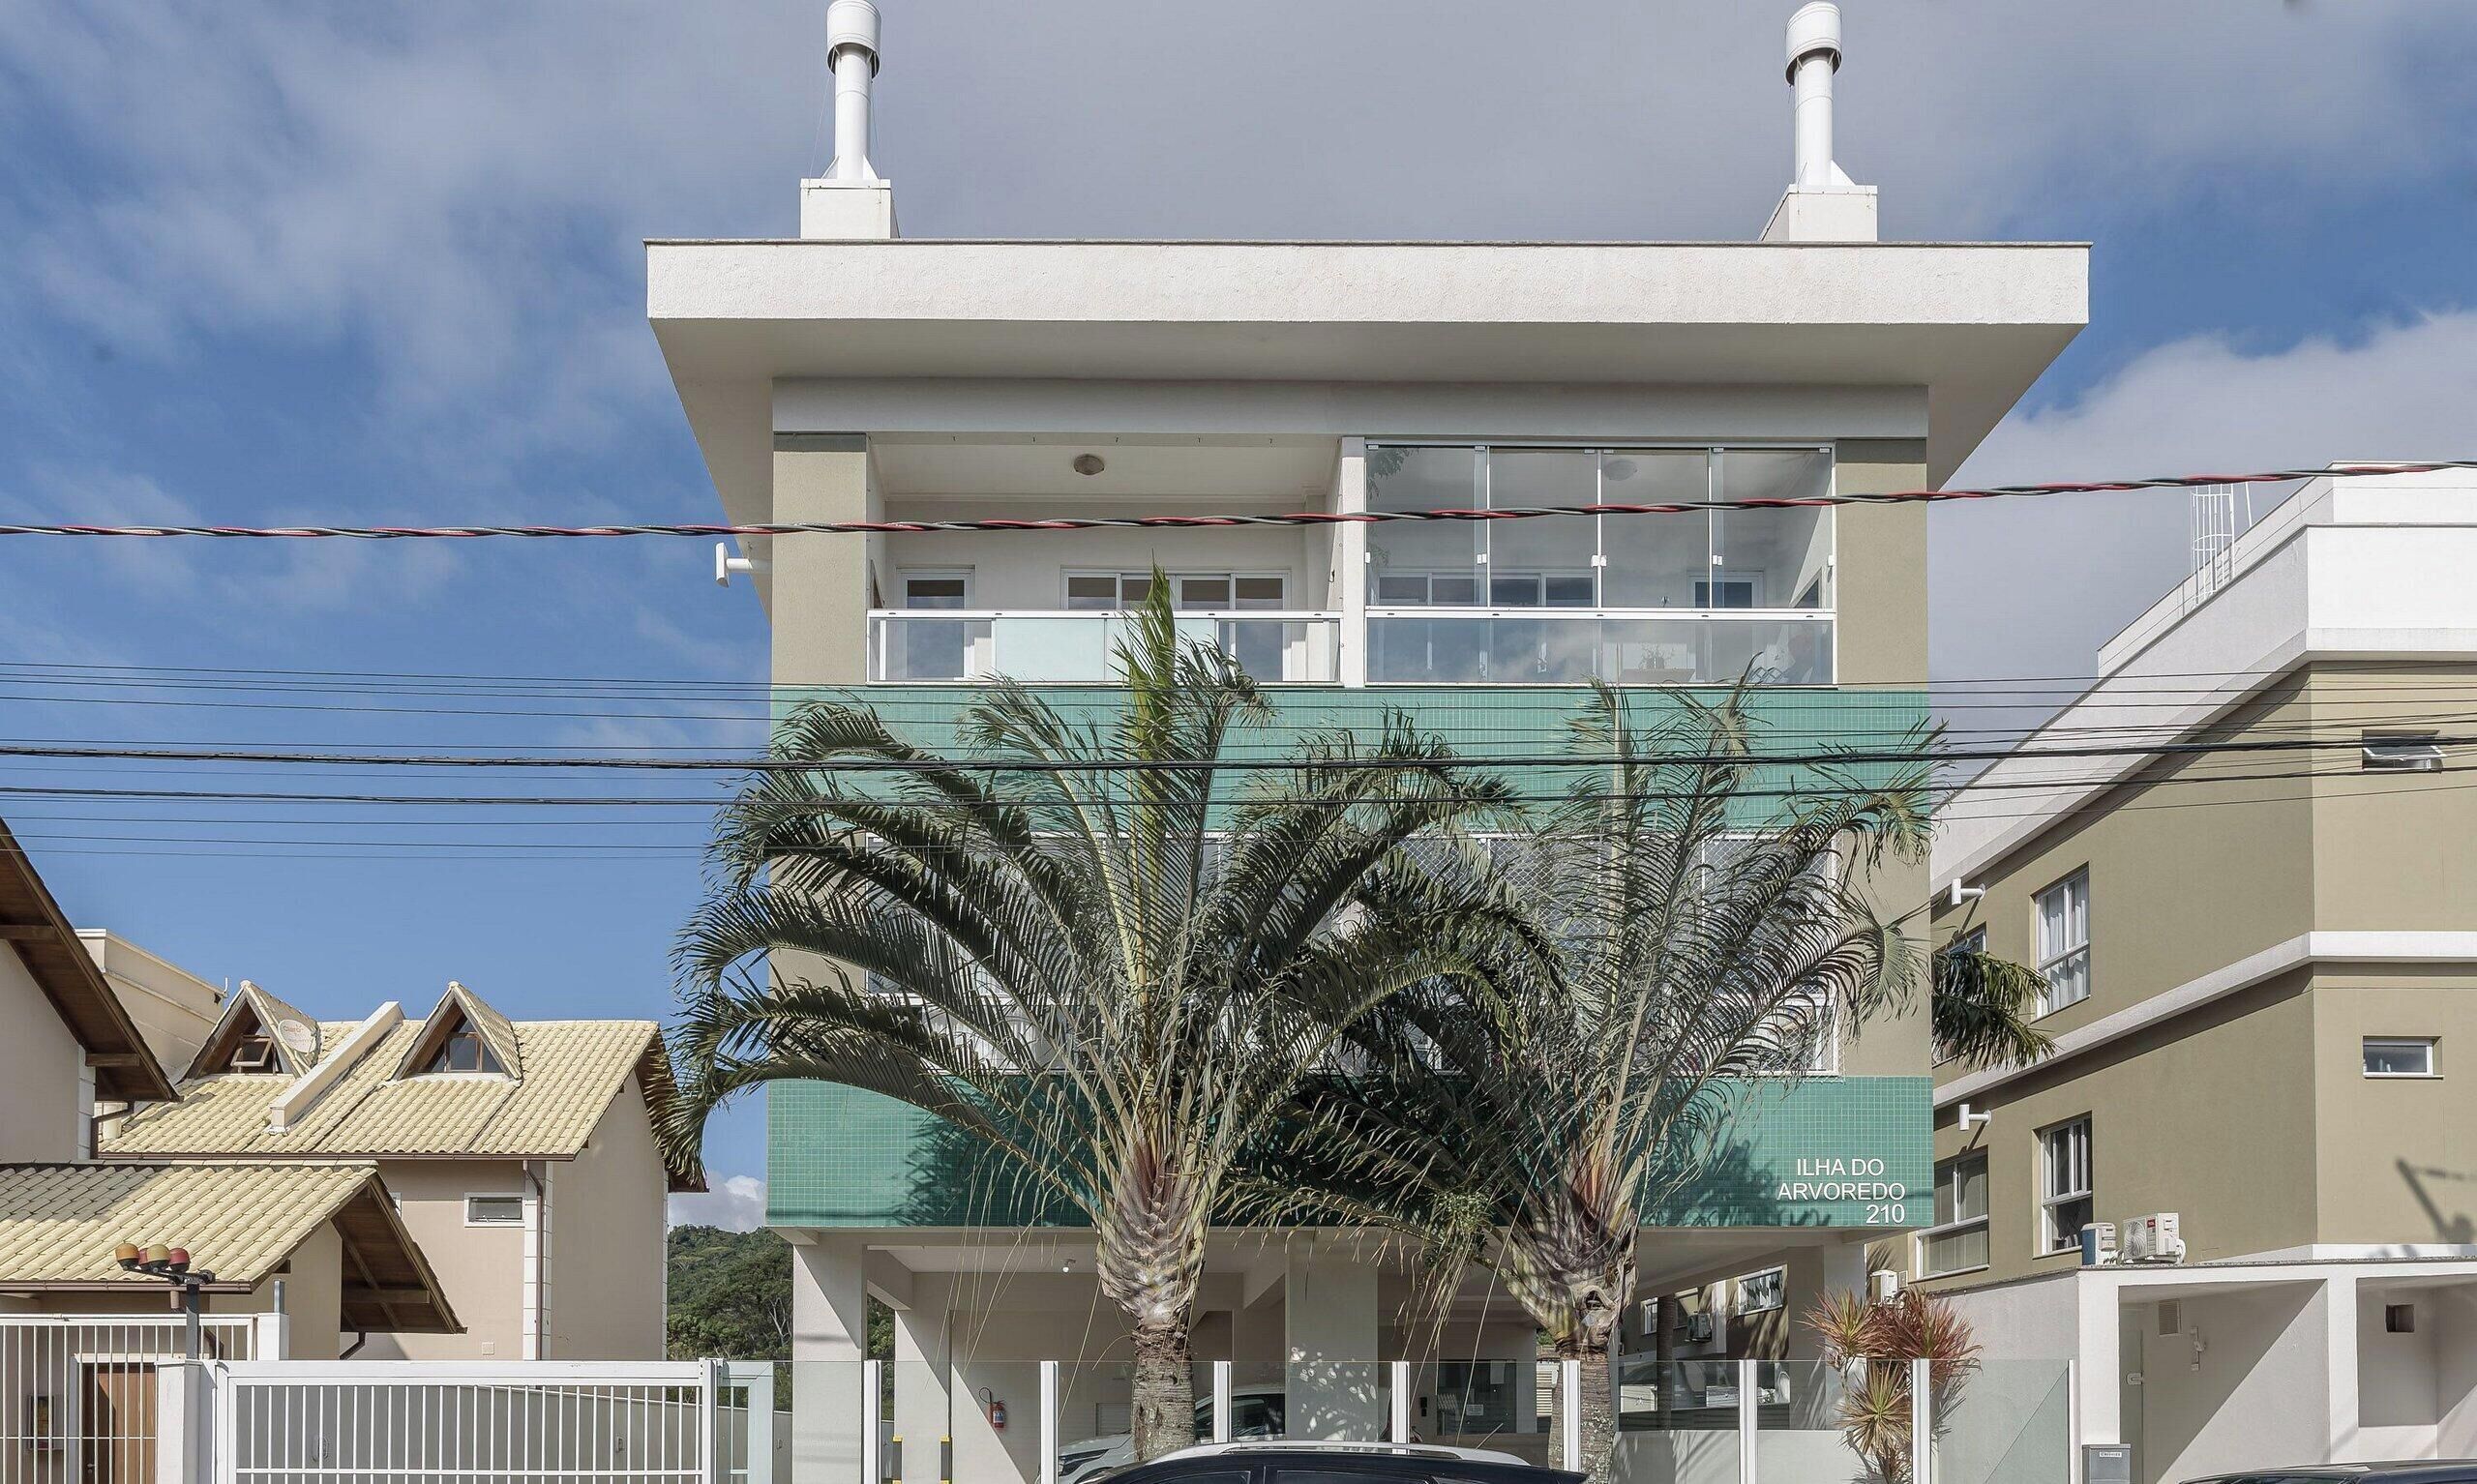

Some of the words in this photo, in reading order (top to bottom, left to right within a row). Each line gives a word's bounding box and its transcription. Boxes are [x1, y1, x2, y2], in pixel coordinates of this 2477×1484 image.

[1797, 1158, 1846, 1176] ILHA
[1851, 1158, 1885, 1176] DO
[1776, 1182, 1906, 1201] ARVOREDO
[1865, 1203, 1905, 1224] 210
